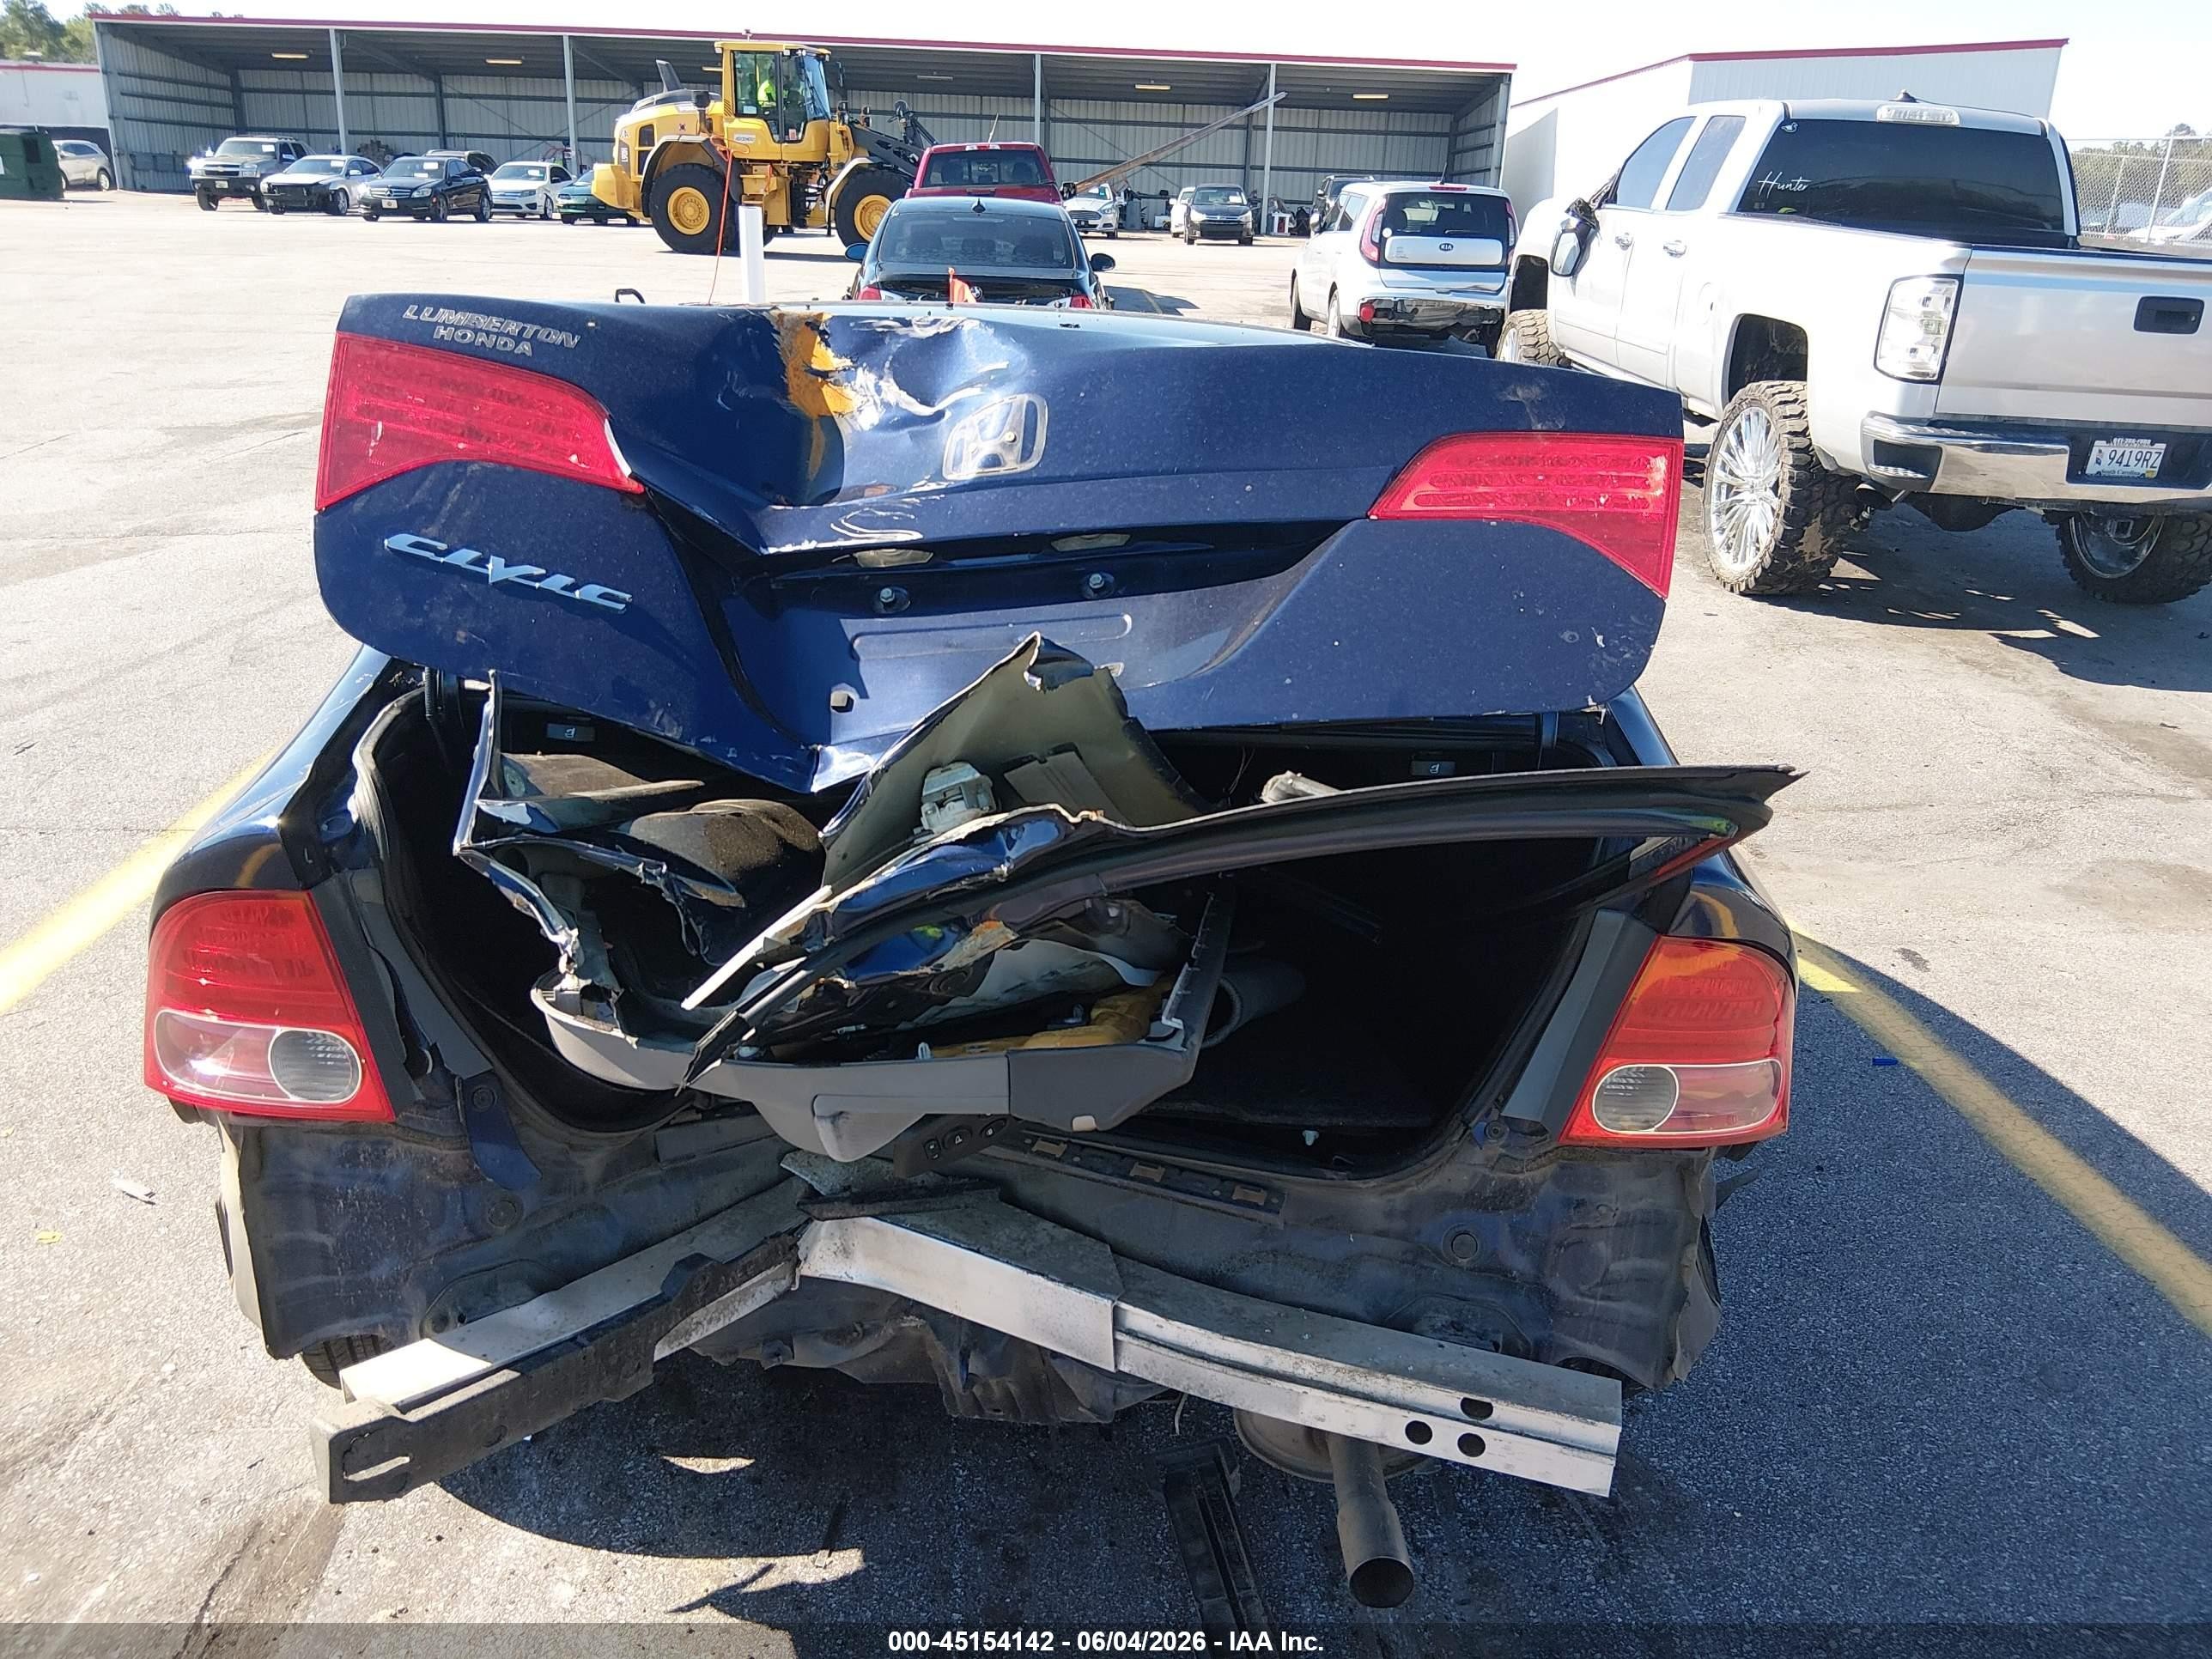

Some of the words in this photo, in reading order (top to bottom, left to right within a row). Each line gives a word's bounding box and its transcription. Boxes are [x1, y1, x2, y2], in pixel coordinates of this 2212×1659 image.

[1758, 171, 1814, 198] Hunter
[402, 304, 581, 349] LUMBERTON
[433, 325, 533, 357] HONDA
[2107, 449, 2162, 469] 9419RZ
[384, 533, 633, 615] CIVIC
